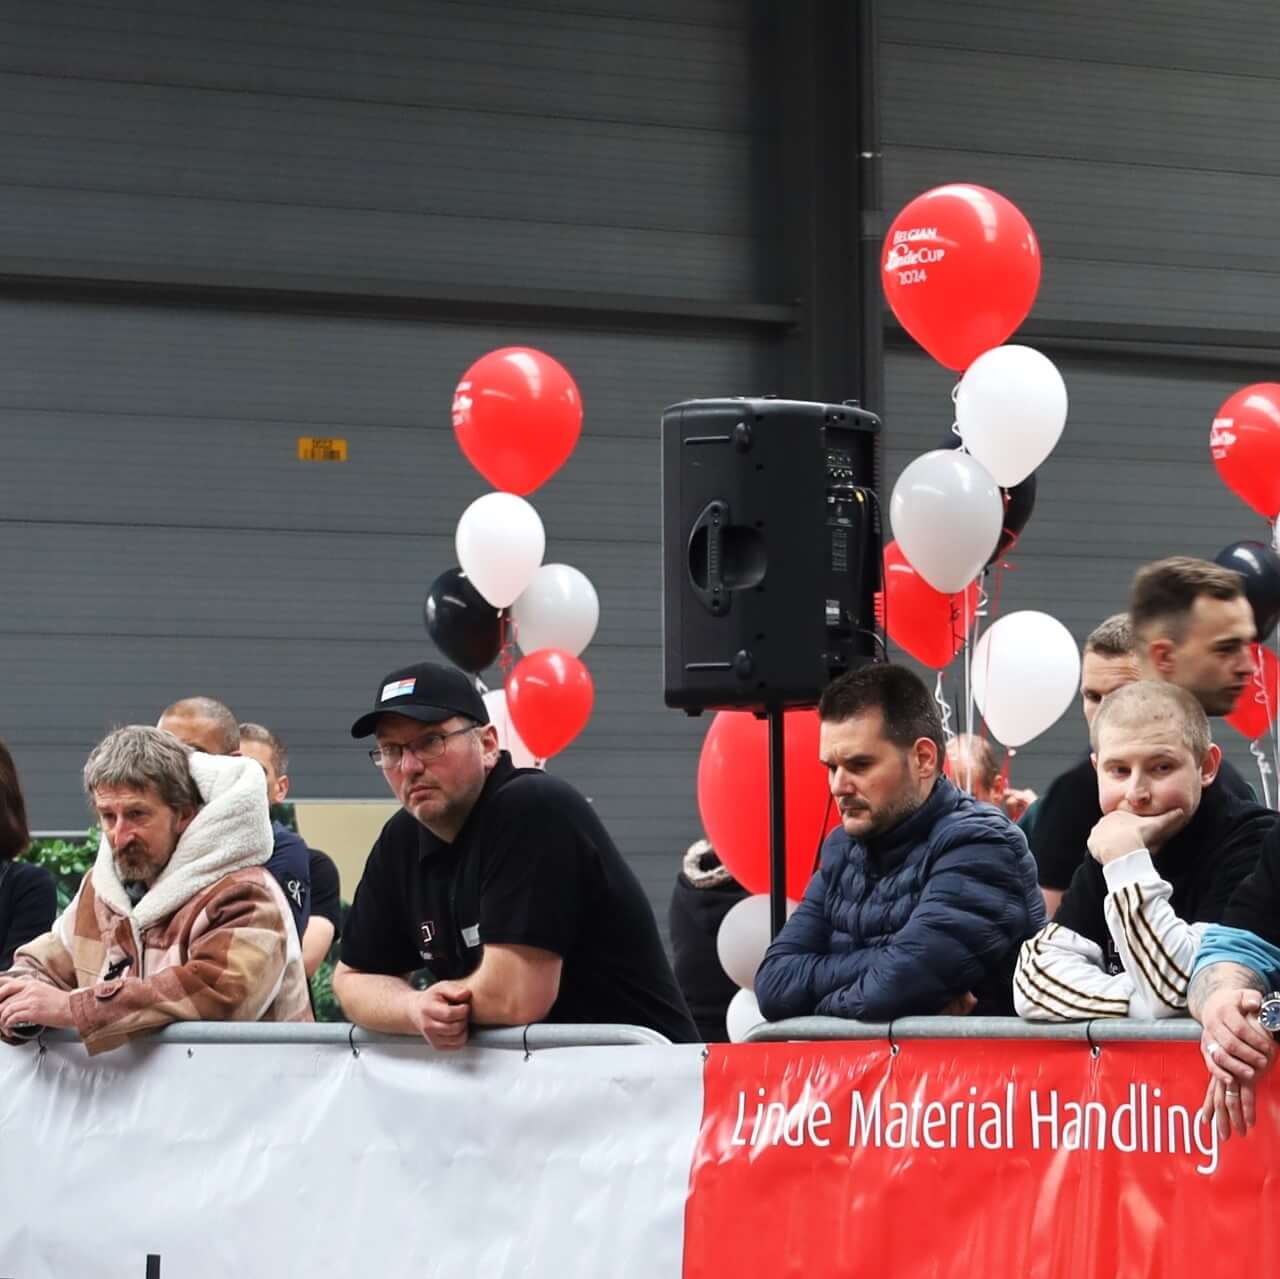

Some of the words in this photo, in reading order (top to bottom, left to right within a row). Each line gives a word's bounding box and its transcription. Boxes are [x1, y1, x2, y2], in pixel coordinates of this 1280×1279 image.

[730, 1087, 832, 1149] Linde
[848, 1082, 1015, 1149] Material
[1030, 1083, 1220, 1175] Handling
